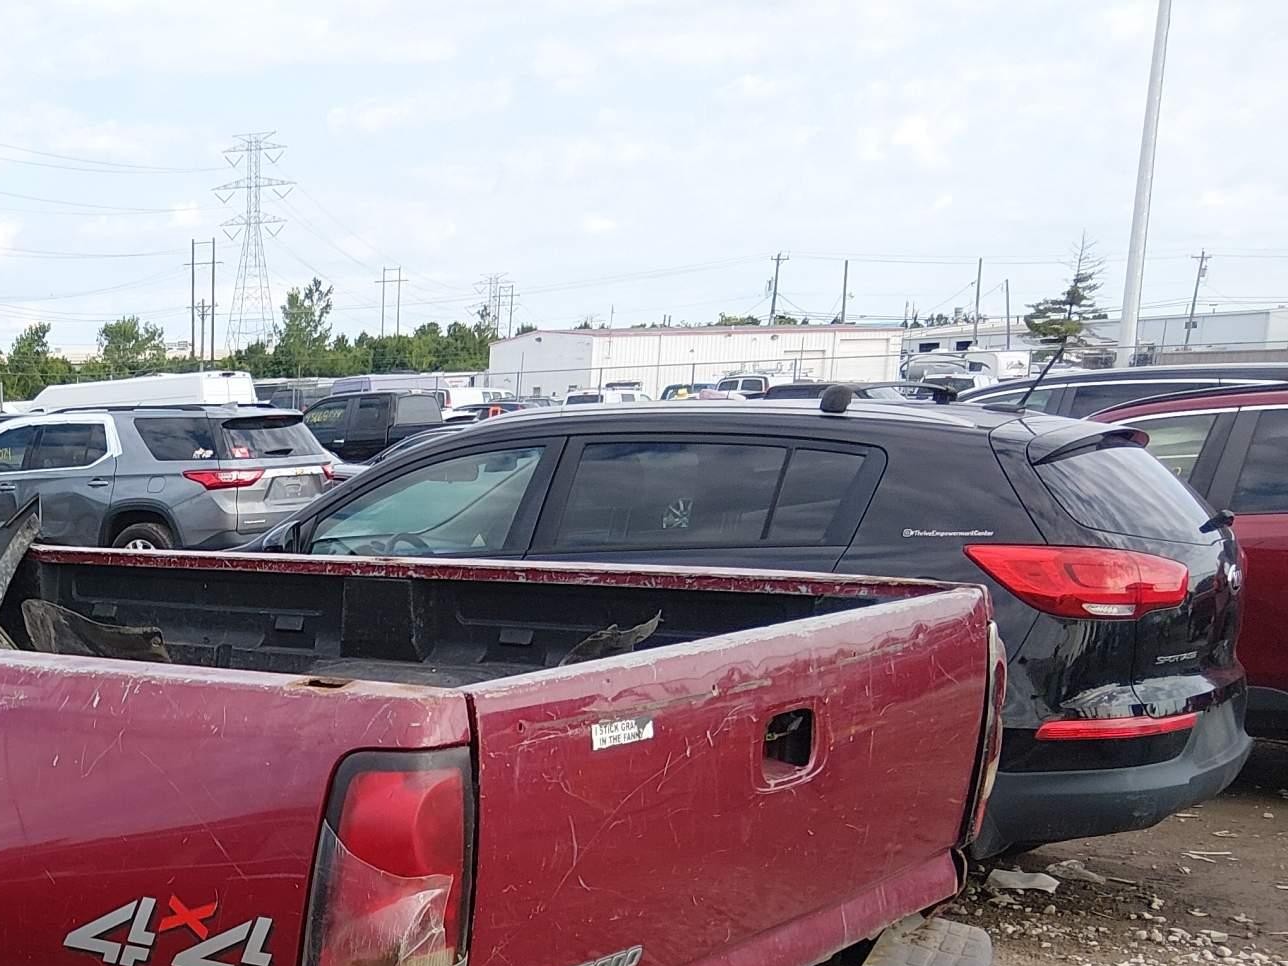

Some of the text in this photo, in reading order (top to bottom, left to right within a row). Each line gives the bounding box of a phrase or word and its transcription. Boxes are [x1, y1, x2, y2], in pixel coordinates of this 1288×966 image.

[599, 722, 619, 735] STICK
[599, 737, 607, 746] IN
[608, 734, 622, 744] THE
